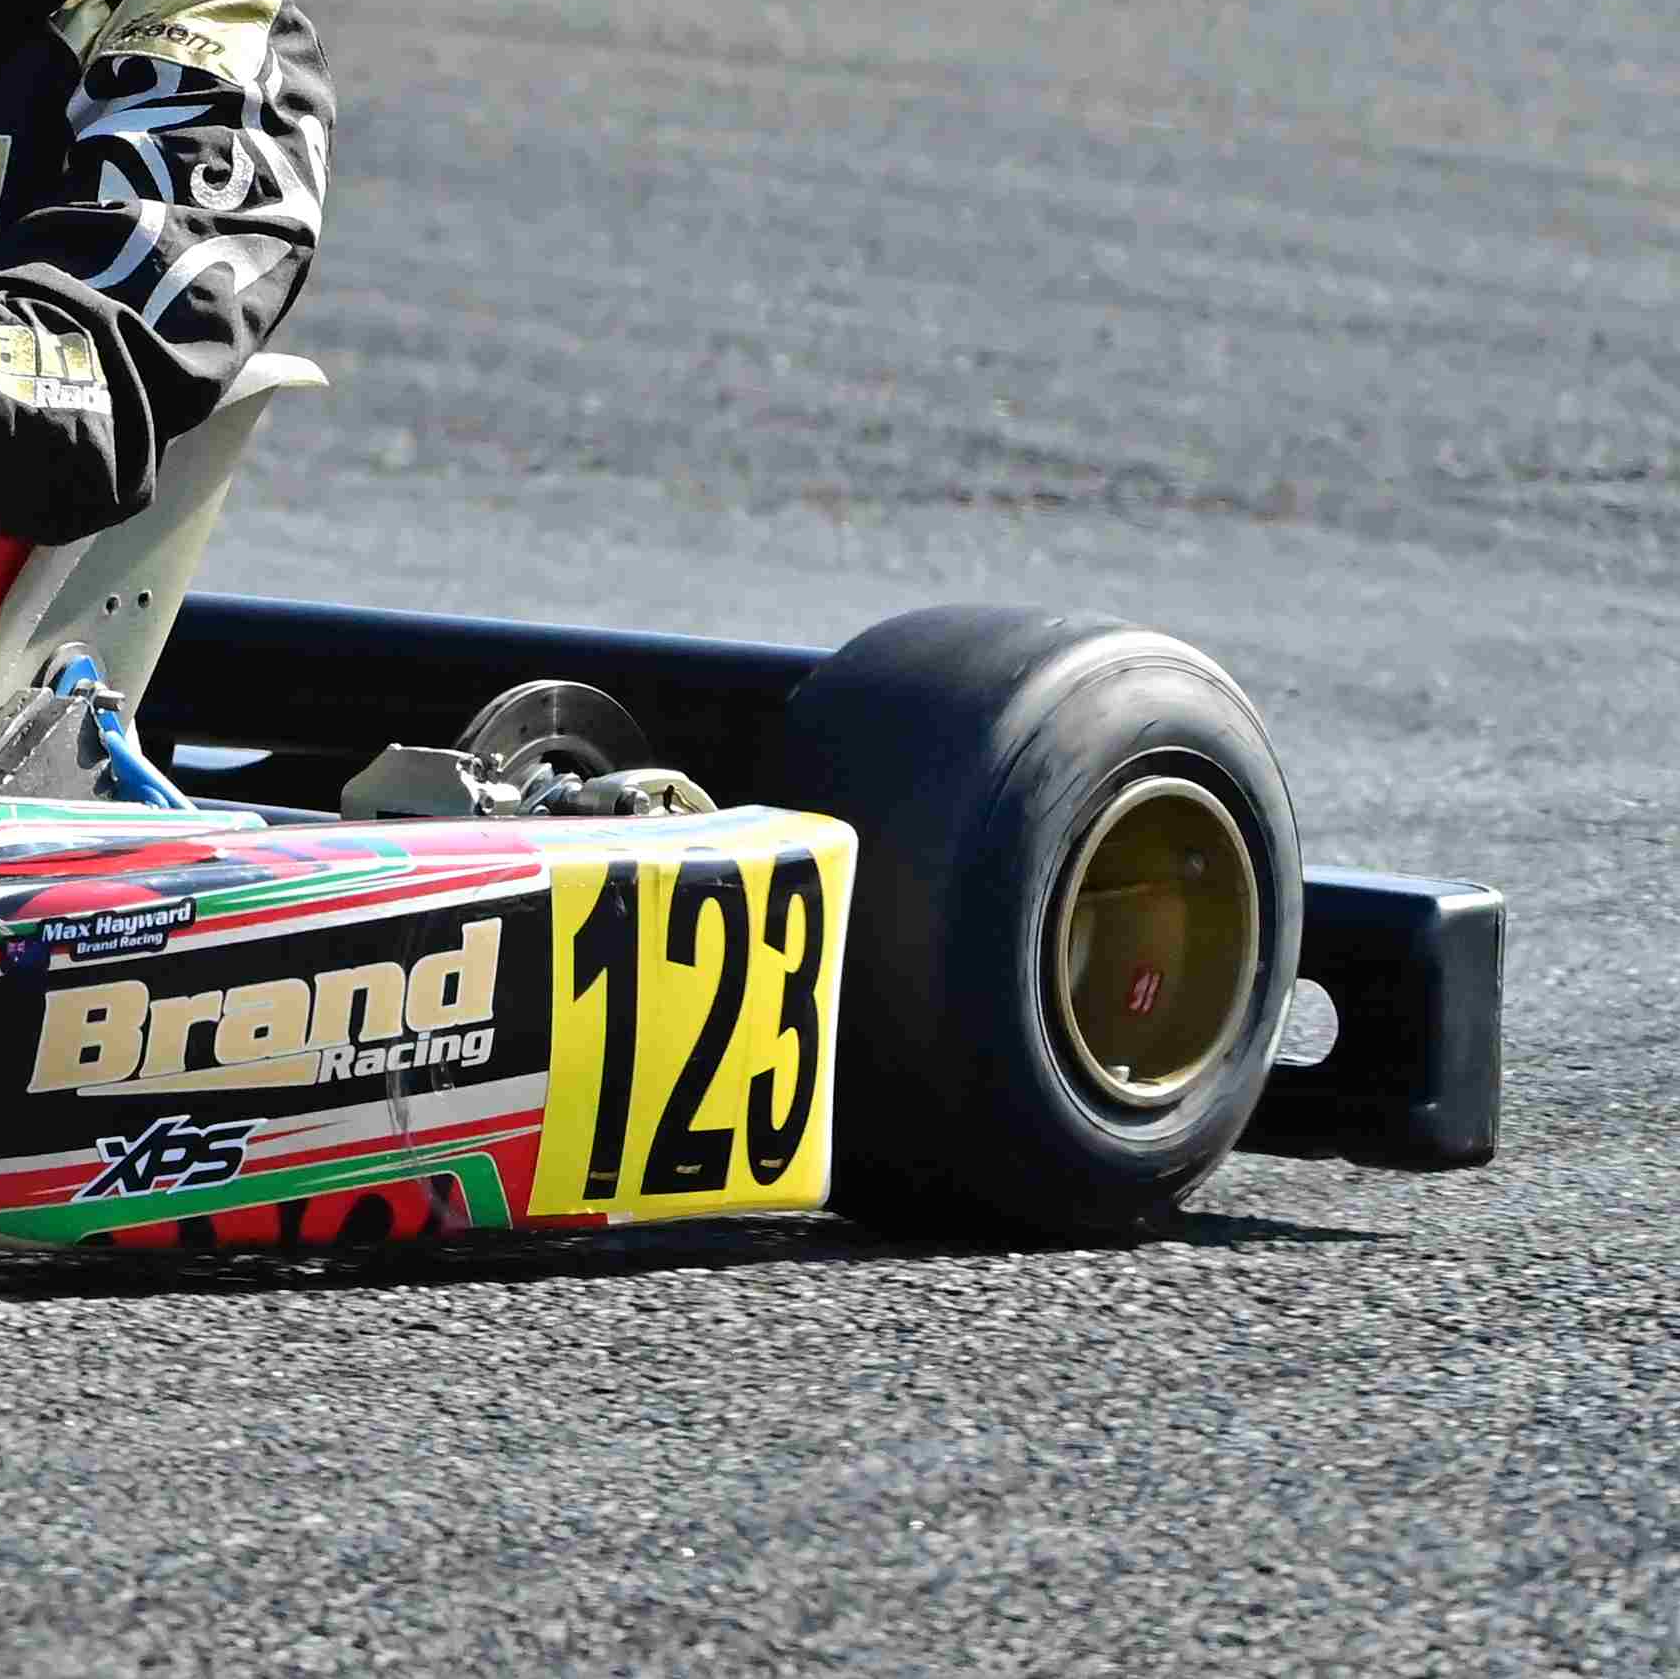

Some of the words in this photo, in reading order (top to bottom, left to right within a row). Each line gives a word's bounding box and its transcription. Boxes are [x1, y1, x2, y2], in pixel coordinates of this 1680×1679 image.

[42, 922, 91, 942] Max
[95, 902, 191, 937] Hayward
[76, 939, 118, 955] Brand
[120, 931, 164, 951] Racing
[27, 917, 503, 1094] Brand
[572, 847, 825, 1201] 123
[316, 1027, 495, 1084] Racing
[71, 1115, 269, 1202] XPS
